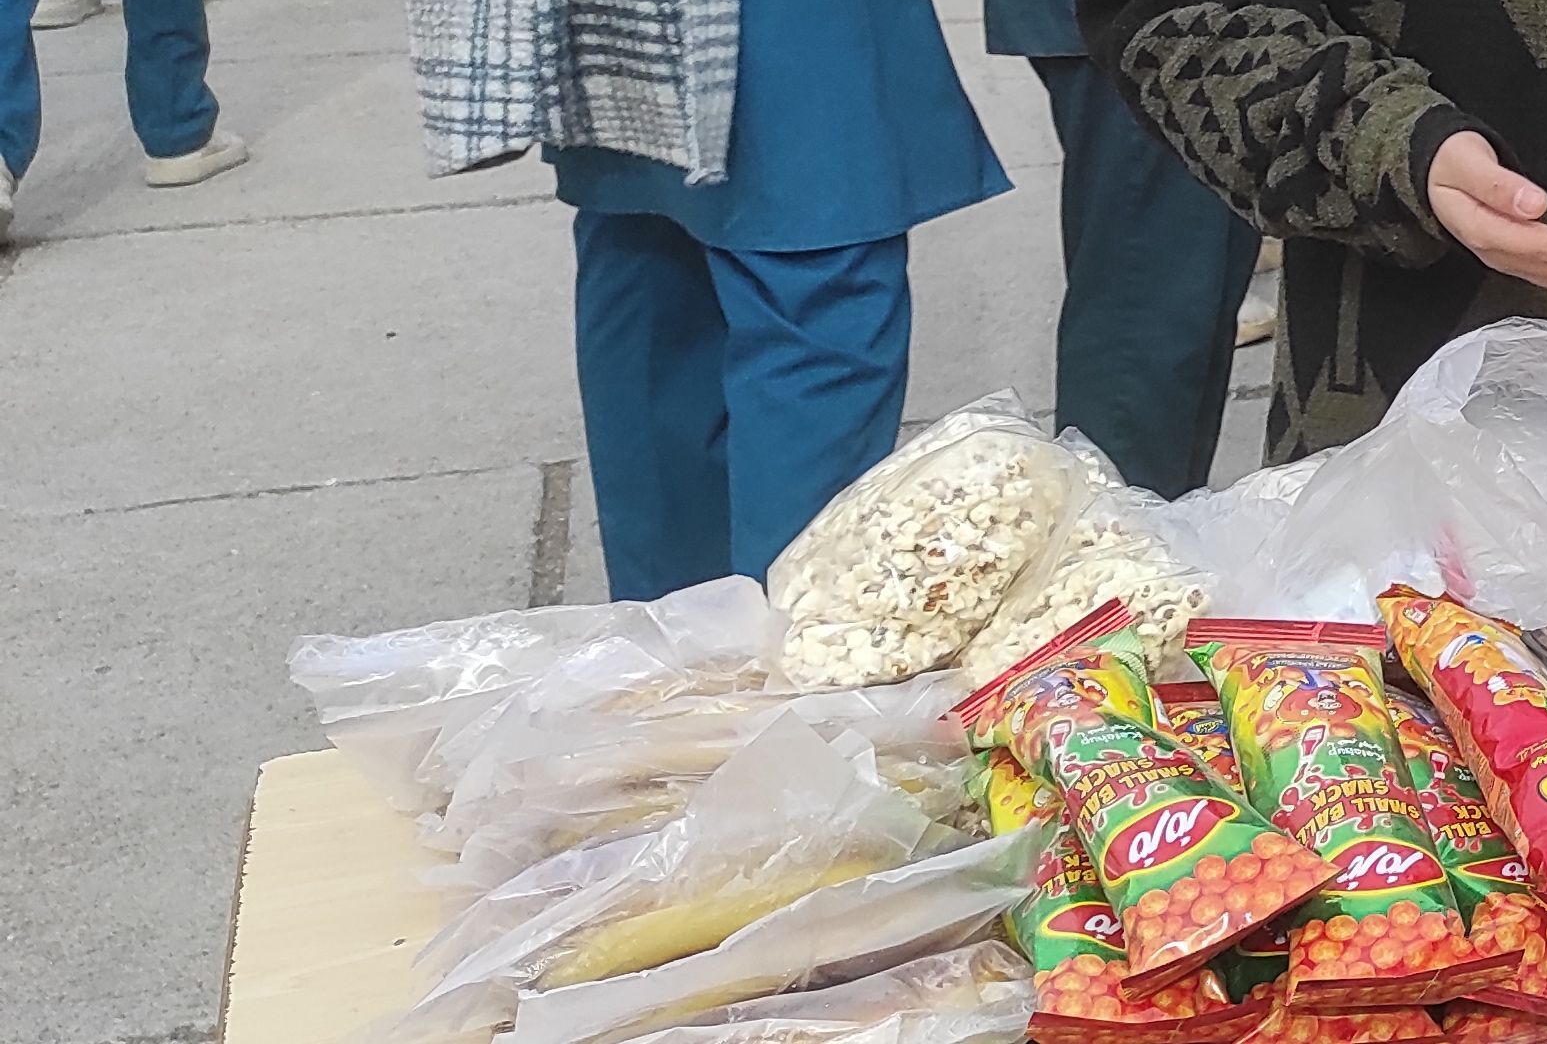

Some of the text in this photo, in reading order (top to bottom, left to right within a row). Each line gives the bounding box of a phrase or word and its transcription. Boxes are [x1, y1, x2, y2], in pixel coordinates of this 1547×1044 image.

[1074, 757, 1155, 798] SNACK
[1118, 763, 1195, 789] SMALL
[1309, 778, 1390, 812] SNACK
[1296, 796, 1421, 844] SMALL BALL
[1440, 821, 1493, 840] BALL
[1041, 868, 1099, 894] BALL
